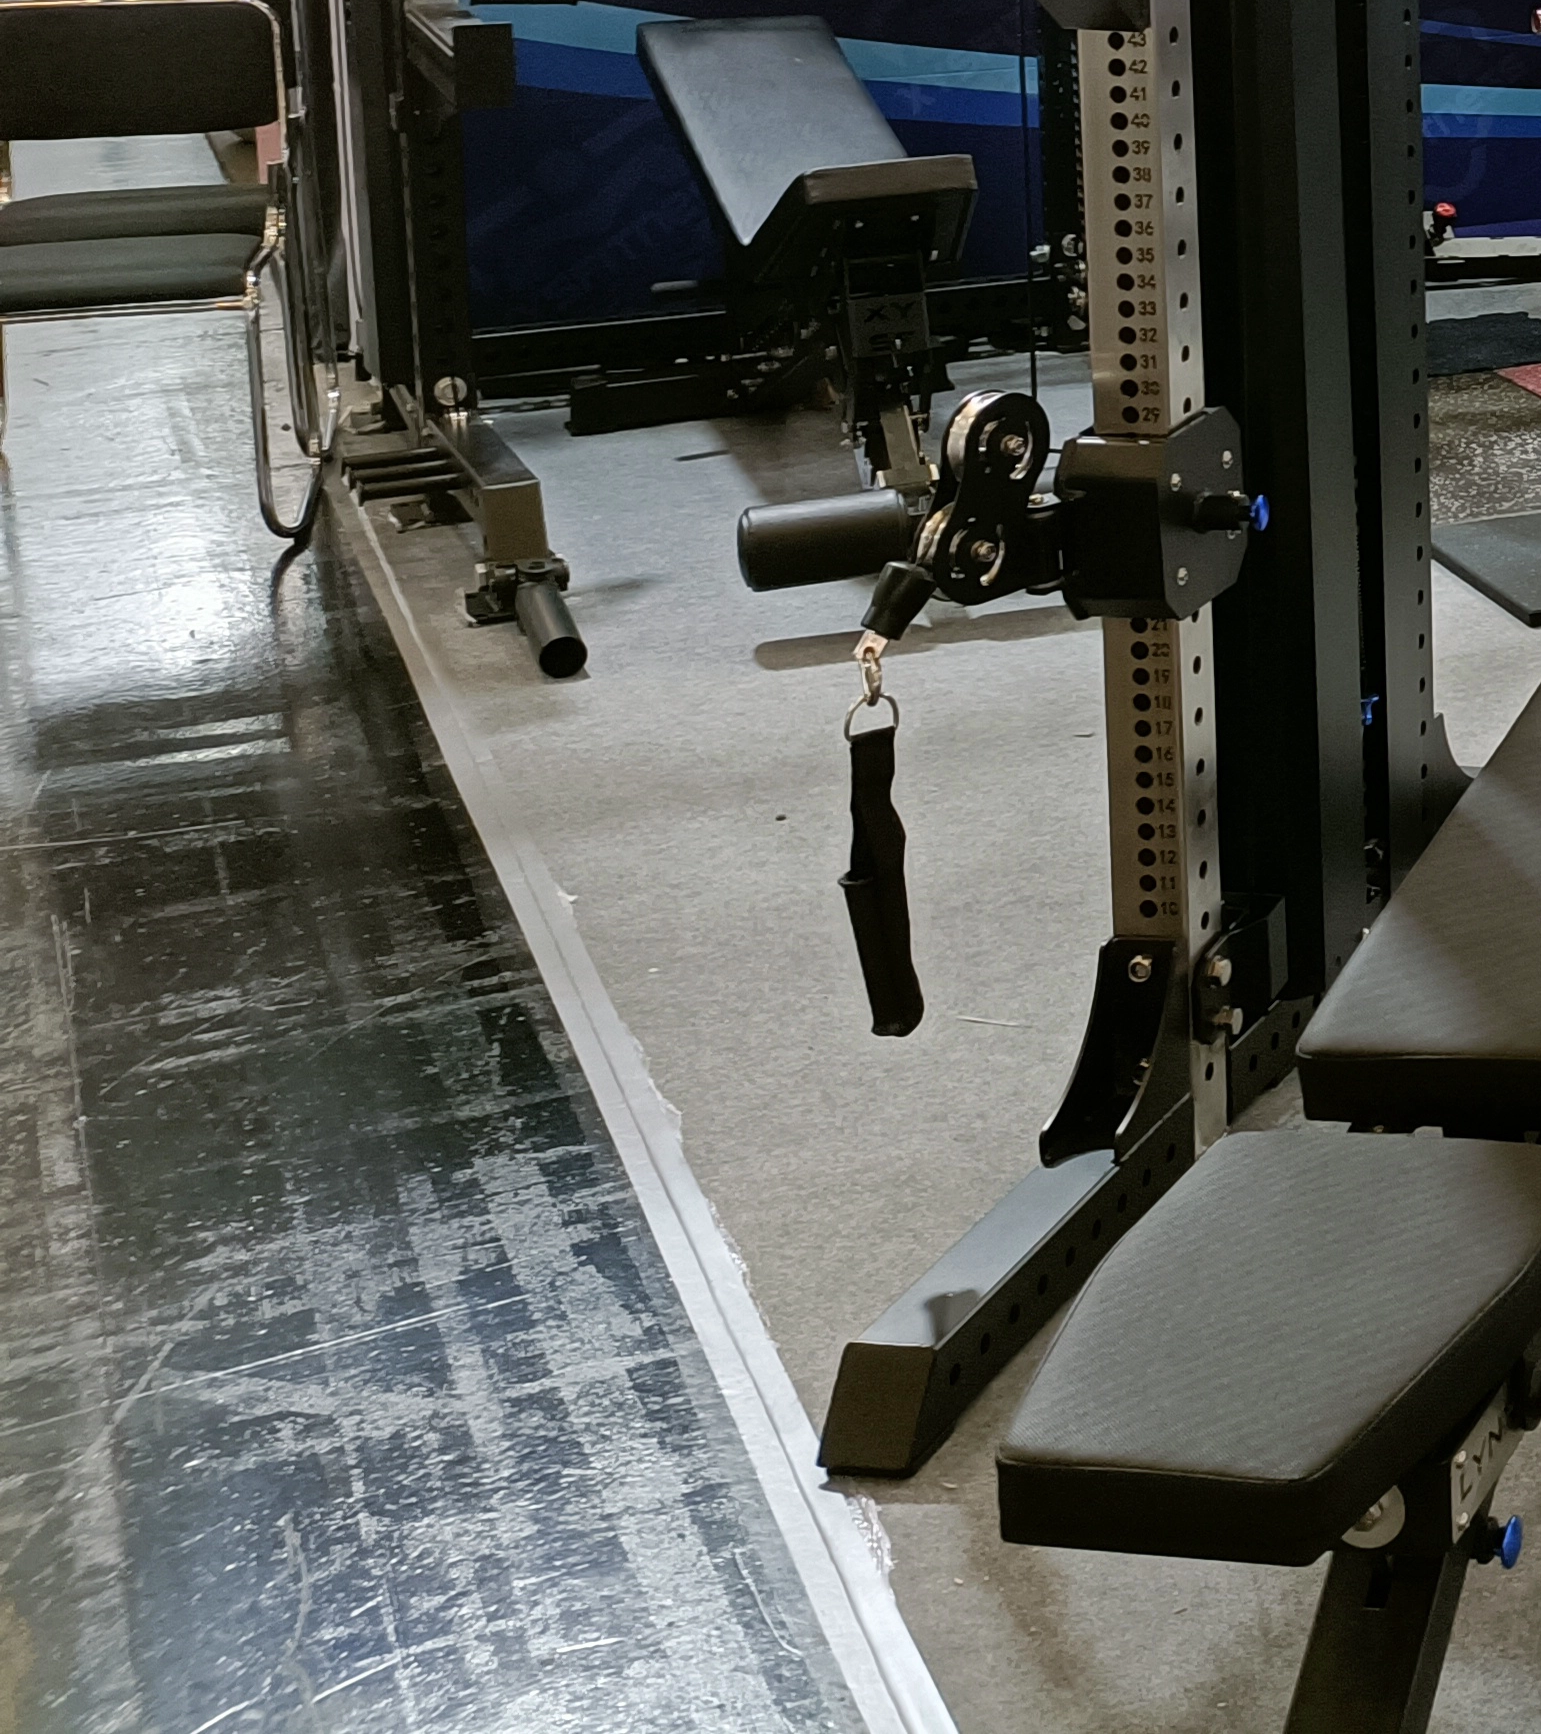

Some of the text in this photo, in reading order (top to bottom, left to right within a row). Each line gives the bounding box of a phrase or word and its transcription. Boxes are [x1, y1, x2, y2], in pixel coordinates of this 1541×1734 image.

[1128, 32, 1146, 47] 43
[1128, 60, 1147, 74] 42
[1130, 87, 1146, 101] 41
[1131, 113, 1150, 128] 40
[1132, 140, 1150, 155] 39
[1133, 167, 1151, 182] 38
[1135, 194, 1153, 209] 37
[1135, 221, 1153, 236] 36
[1137, 248, 1154, 263] 35
[1138, 274, 1156, 290] 34
[1139, 301, 1156, 316] 33
[1140, 328, 1157, 343] 32
[1140, 354, 1157, 369] 31
[1141, 381, 1160, 395] 30
[1142, 407, 1160, 423] 29
[1152, 643, 1170, 657] 20
[1154, 669, 1170, 684] 19
[1156, 721, 1173, 735] 17
[1156, 746, 1173, 762] 16
[1157, 772, 1174, 787] 15
[1157, 799, 1175, 813] 14
[1159, 824, 1176, 839] 13
[1160, 850, 1176, 864] 12
[1160, 876, 1175, 891] 11
[1161, 902, 1179, 916] 10
[1459, 1416, 1504, 1502] LYN
